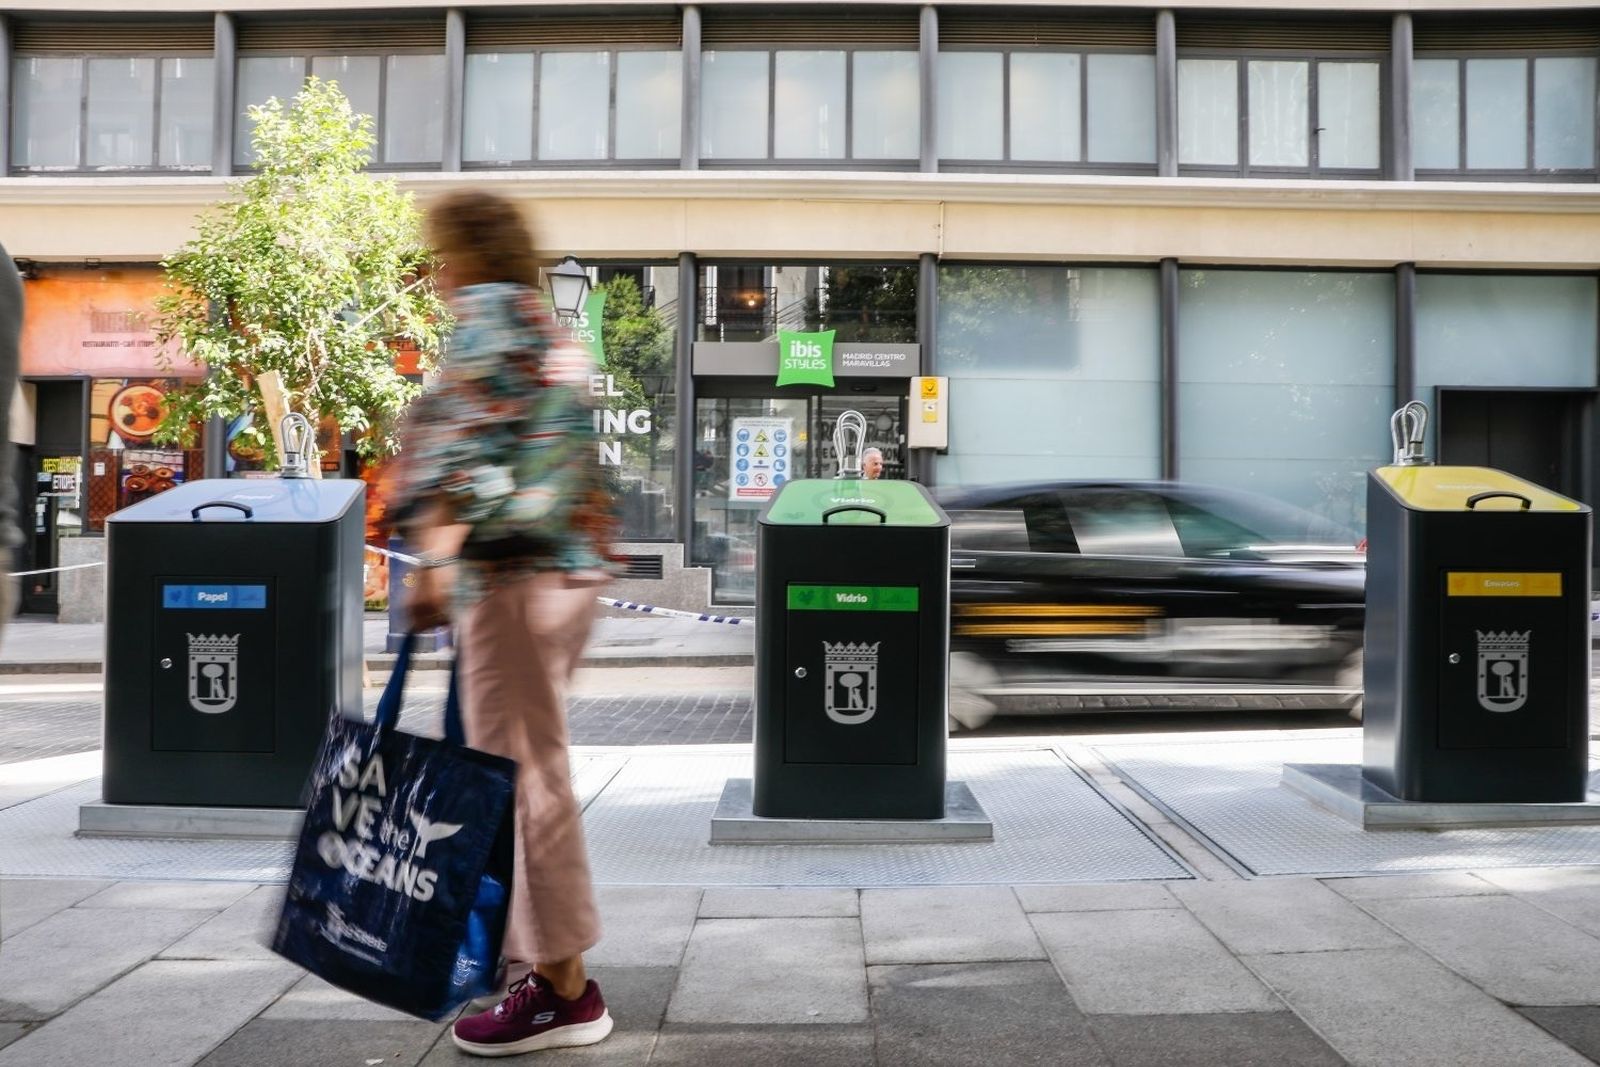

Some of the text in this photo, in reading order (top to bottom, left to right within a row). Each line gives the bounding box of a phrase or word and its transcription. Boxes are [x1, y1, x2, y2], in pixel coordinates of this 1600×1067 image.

[790, 340, 821, 358] ibis
[842, 353, 906, 361] MADRID CENTRO
[785, 358, 827, 370] STYLES
[842, 360, 891, 368] MARAVILLAS
[588, 374, 624, 397] EL
[592, 409, 652, 434] ING
[598, 441, 622, 466] N
[197, 592, 228, 603] Papel
[835, 593, 868, 603] Vidrio
[379, 816, 410, 851] the
[316, 830, 438, 902] OCEANS
